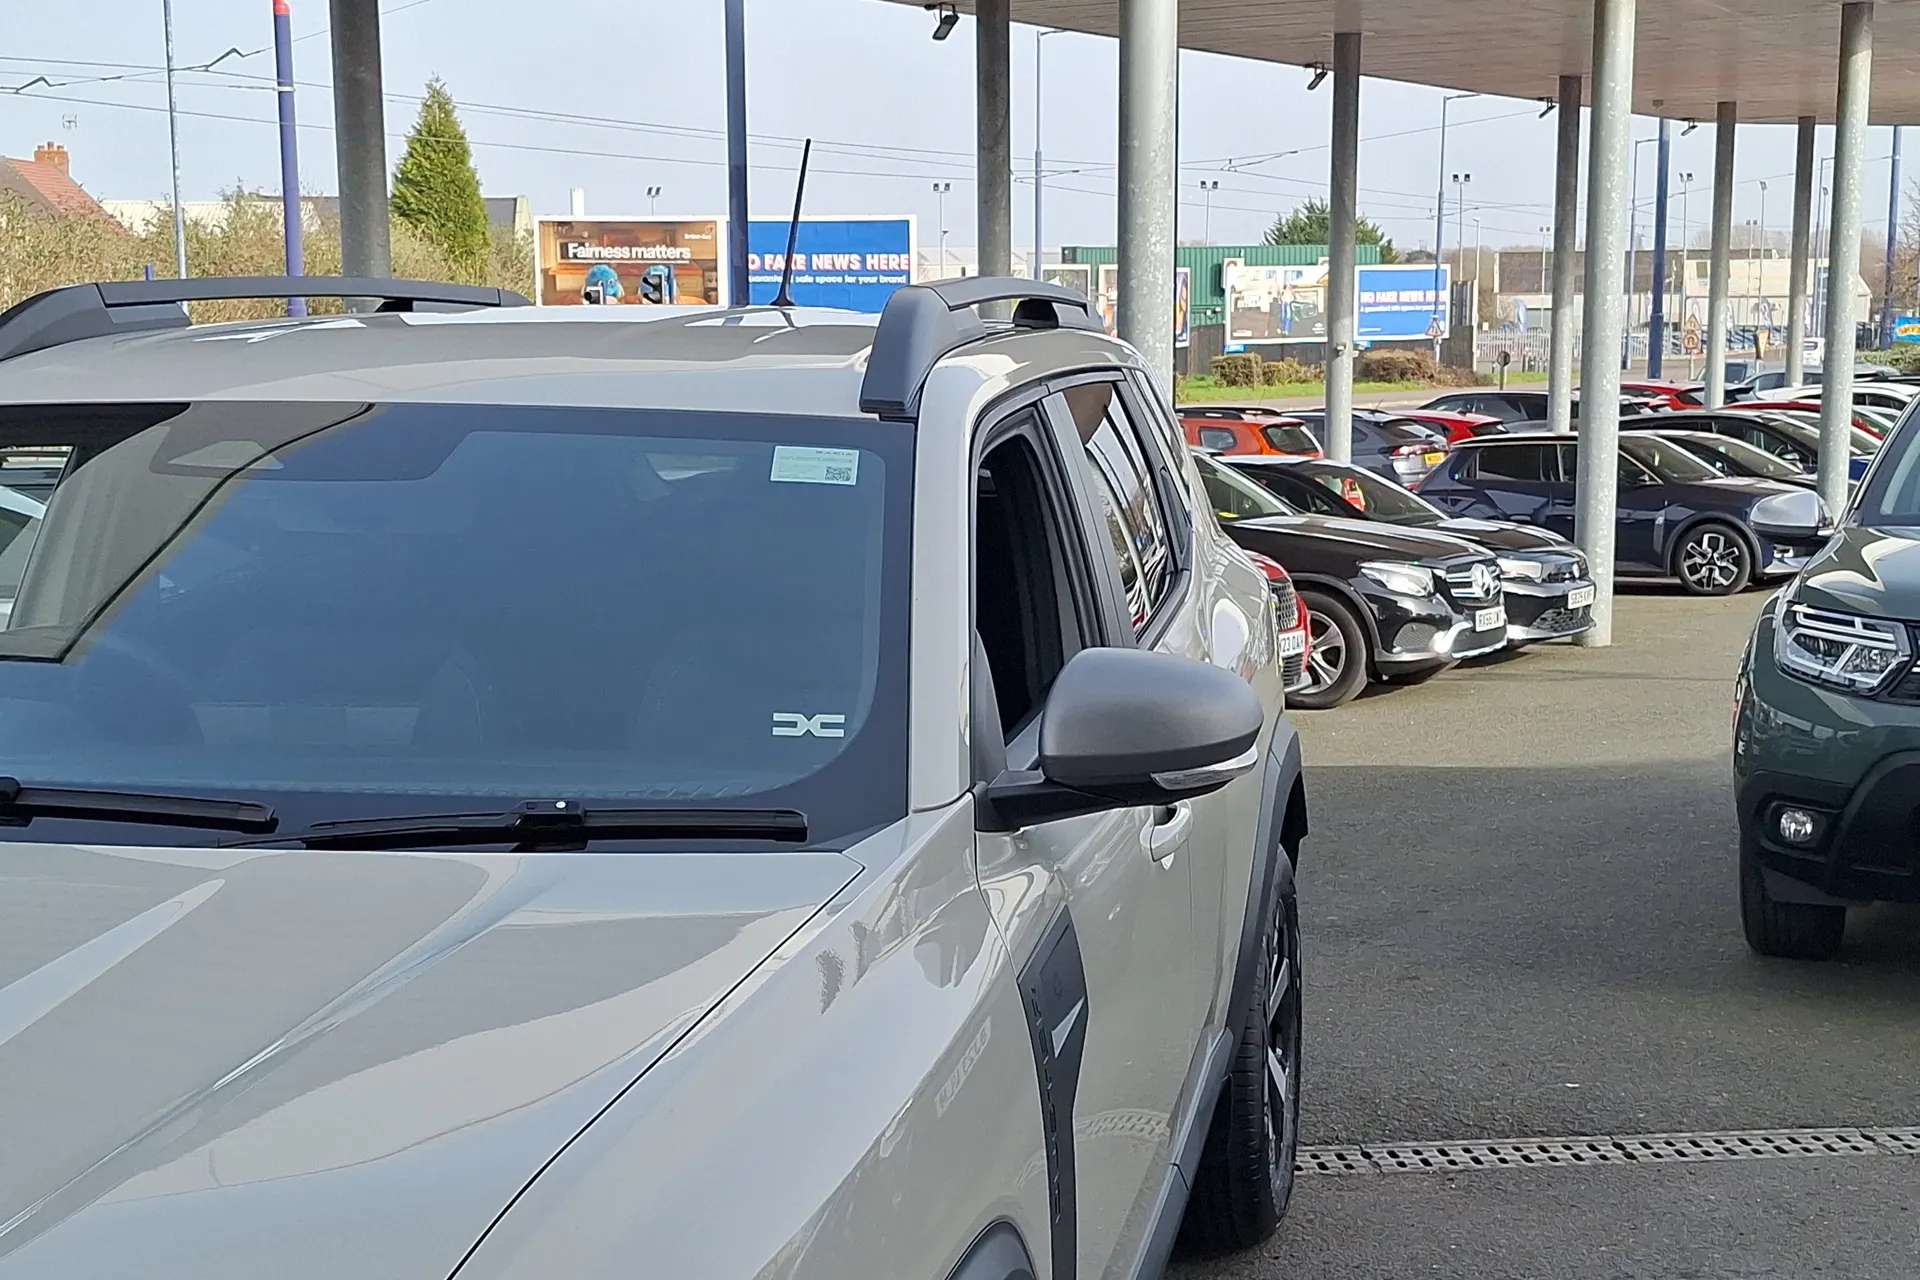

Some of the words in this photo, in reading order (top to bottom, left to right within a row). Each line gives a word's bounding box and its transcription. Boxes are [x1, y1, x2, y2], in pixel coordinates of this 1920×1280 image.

[567, 242, 632, 259] Fairness
[631, 245, 692, 260] matters
[811, 253, 862, 272] NEWS
[865, 253, 910, 272] HERE
[858, 276, 879, 285] your
